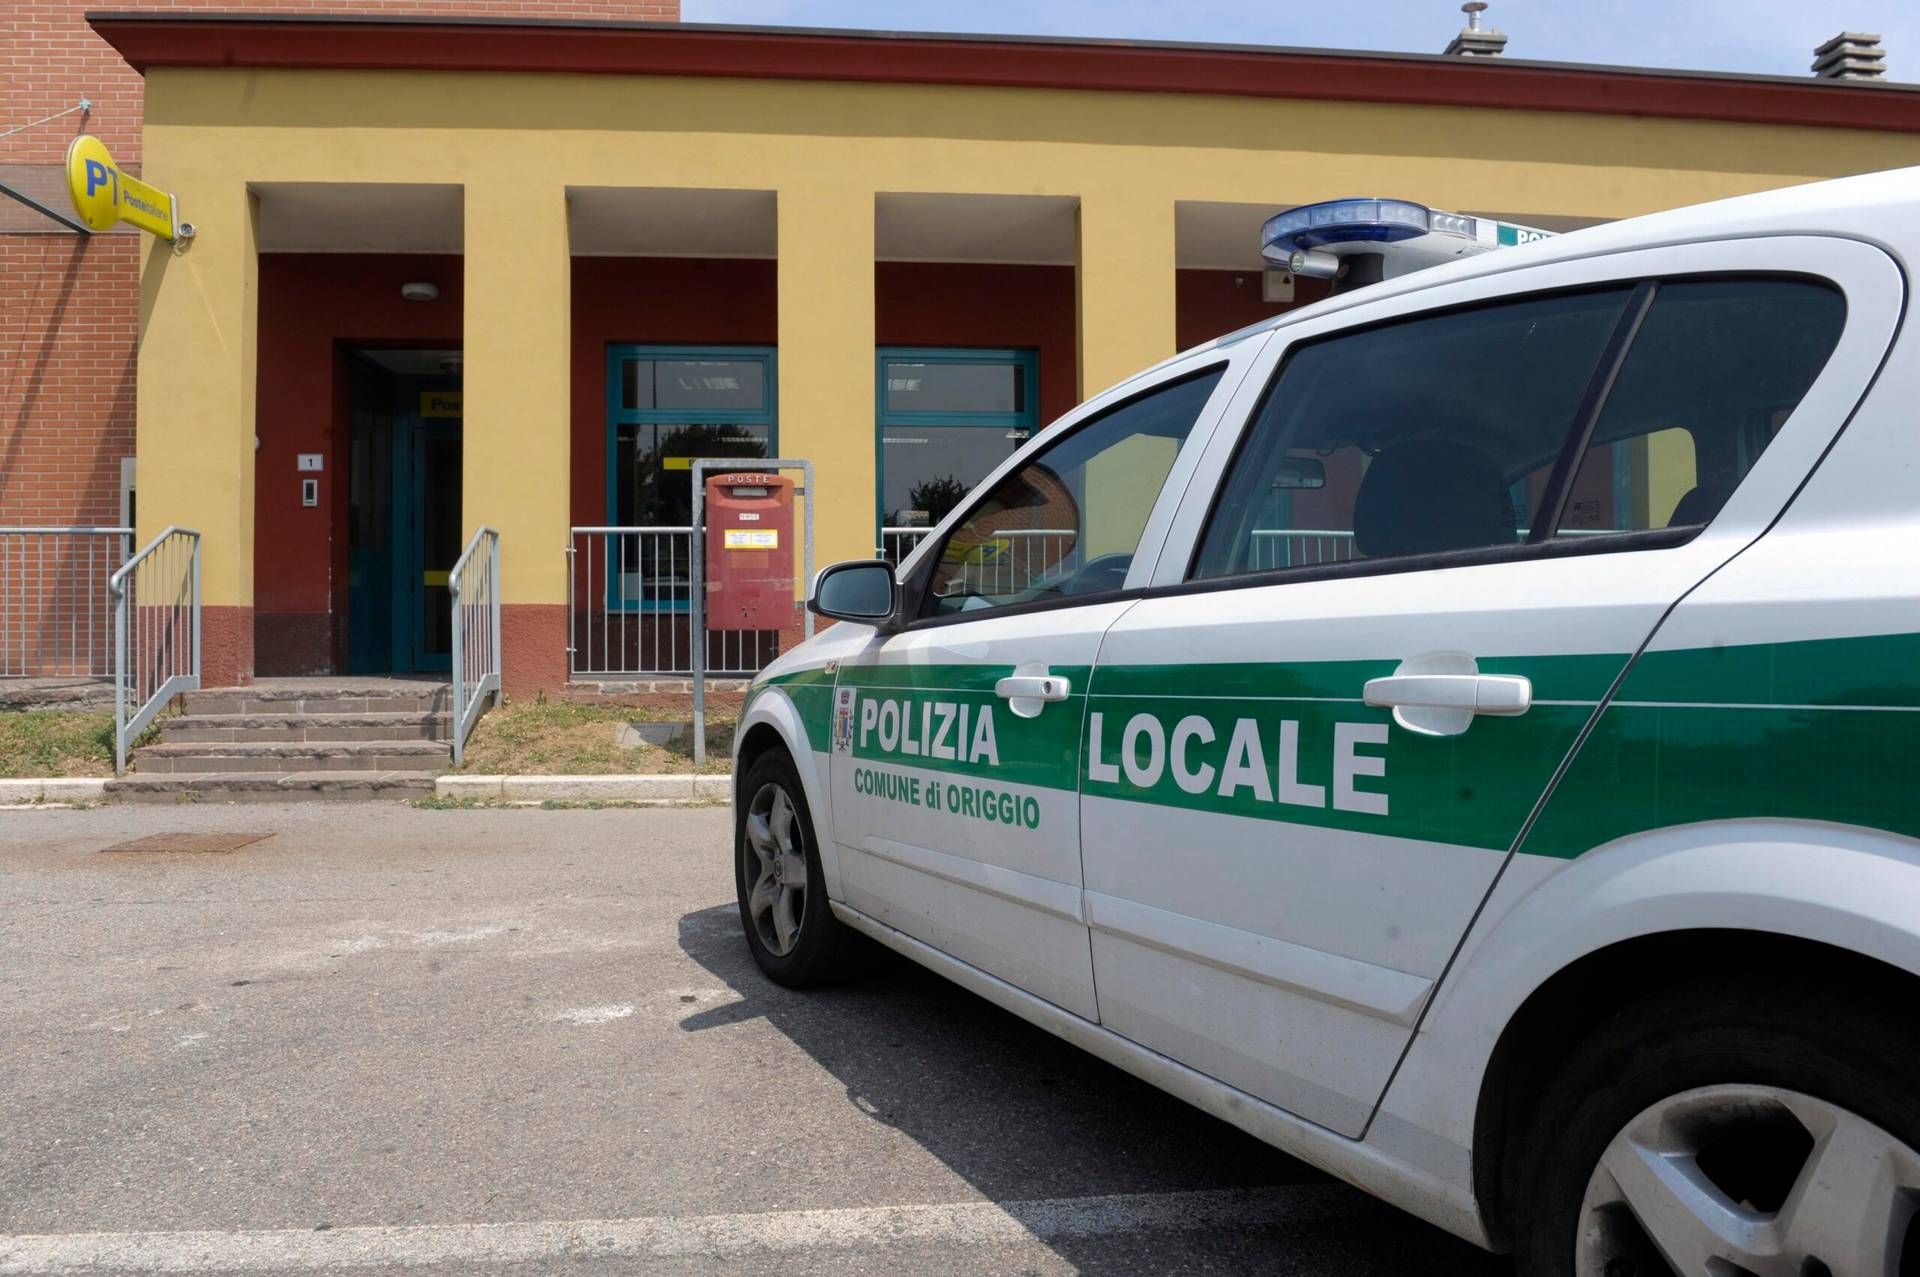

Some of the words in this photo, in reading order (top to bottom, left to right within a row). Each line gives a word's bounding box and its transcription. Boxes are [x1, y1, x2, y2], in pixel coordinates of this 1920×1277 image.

[309, 458, 314, 467] 1
[727, 475, 770, 484] POSTE
[859, 698, 1000, 767] POLIZIA
[1088, 711, 1390, 817] LOCALE
[854, 767, 921, 806] COMUNE
[925, 780, 941, 811] di
[946, 784, 1041, 830] ORIGGIO
